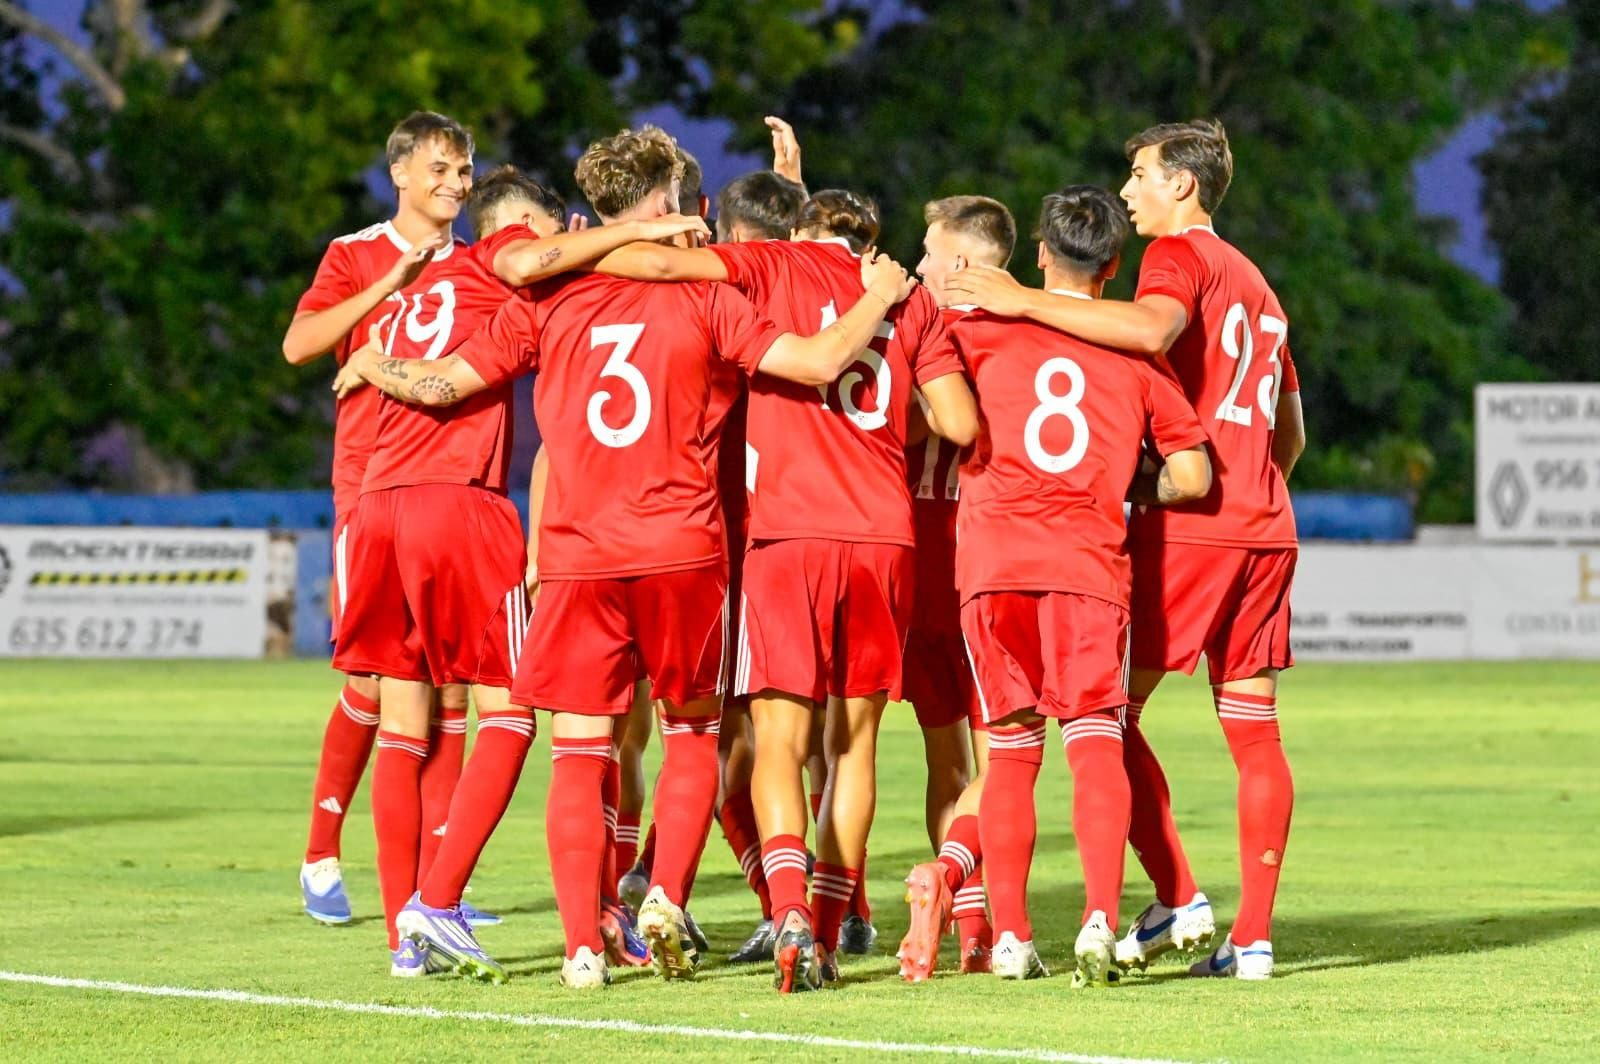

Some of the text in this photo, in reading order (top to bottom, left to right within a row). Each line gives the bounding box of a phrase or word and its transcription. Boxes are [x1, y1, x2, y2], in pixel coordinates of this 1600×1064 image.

[1215, 302, 1288, 430] 23
[587, 323, 652, 448] 3
[1024, 357, 1090, 474] 8
[1488, 395, 1578, 423] MOTOR
[1533, 459, 1588, 491] 956
[9, 617, 204, 650] 635 612 374
[1291, 638, 1413, 653] ONSTRUCCION
